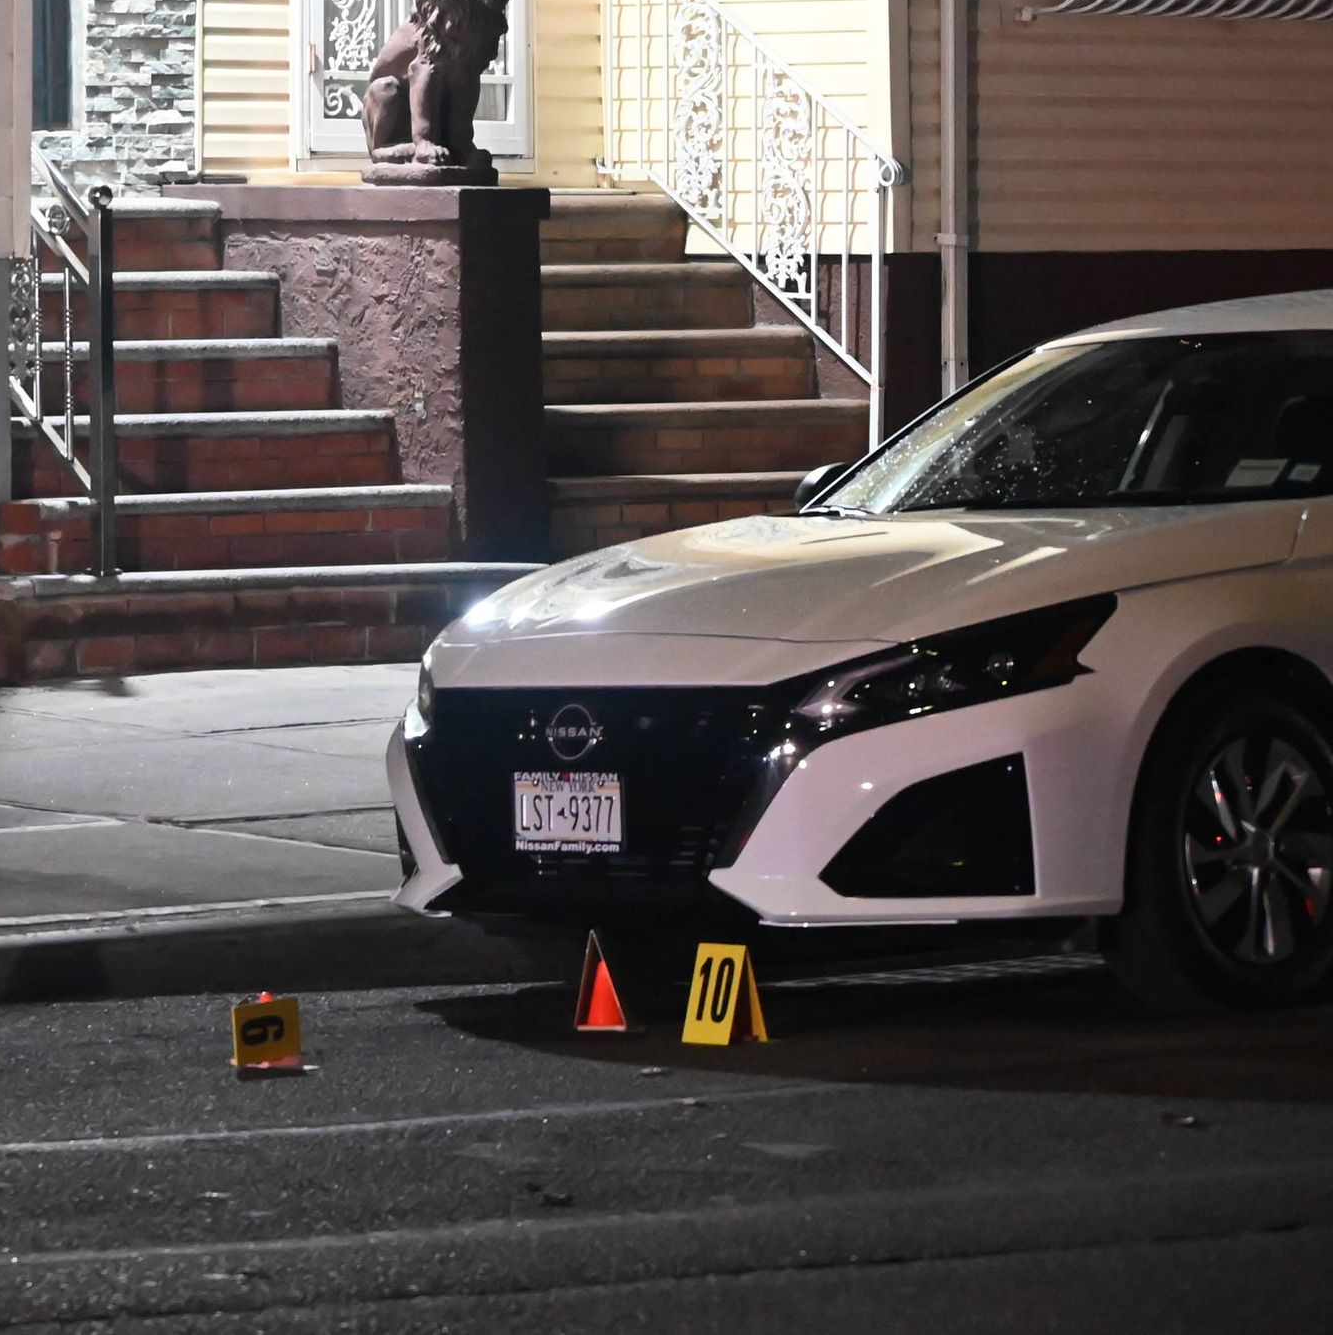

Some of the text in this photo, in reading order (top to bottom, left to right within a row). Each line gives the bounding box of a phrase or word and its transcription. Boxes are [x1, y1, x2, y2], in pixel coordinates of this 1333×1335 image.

[545, 726, 601, 738] NISSAN
[513, 771, 619, 782] FAMILY NISSAN
[540, 780, 597, 793] NEW YORK
[520, 794, 615, 834] LST 9377
[515, 840, 621, 855] NissanFamily.com
[696, 956, 736, 1023] 10
